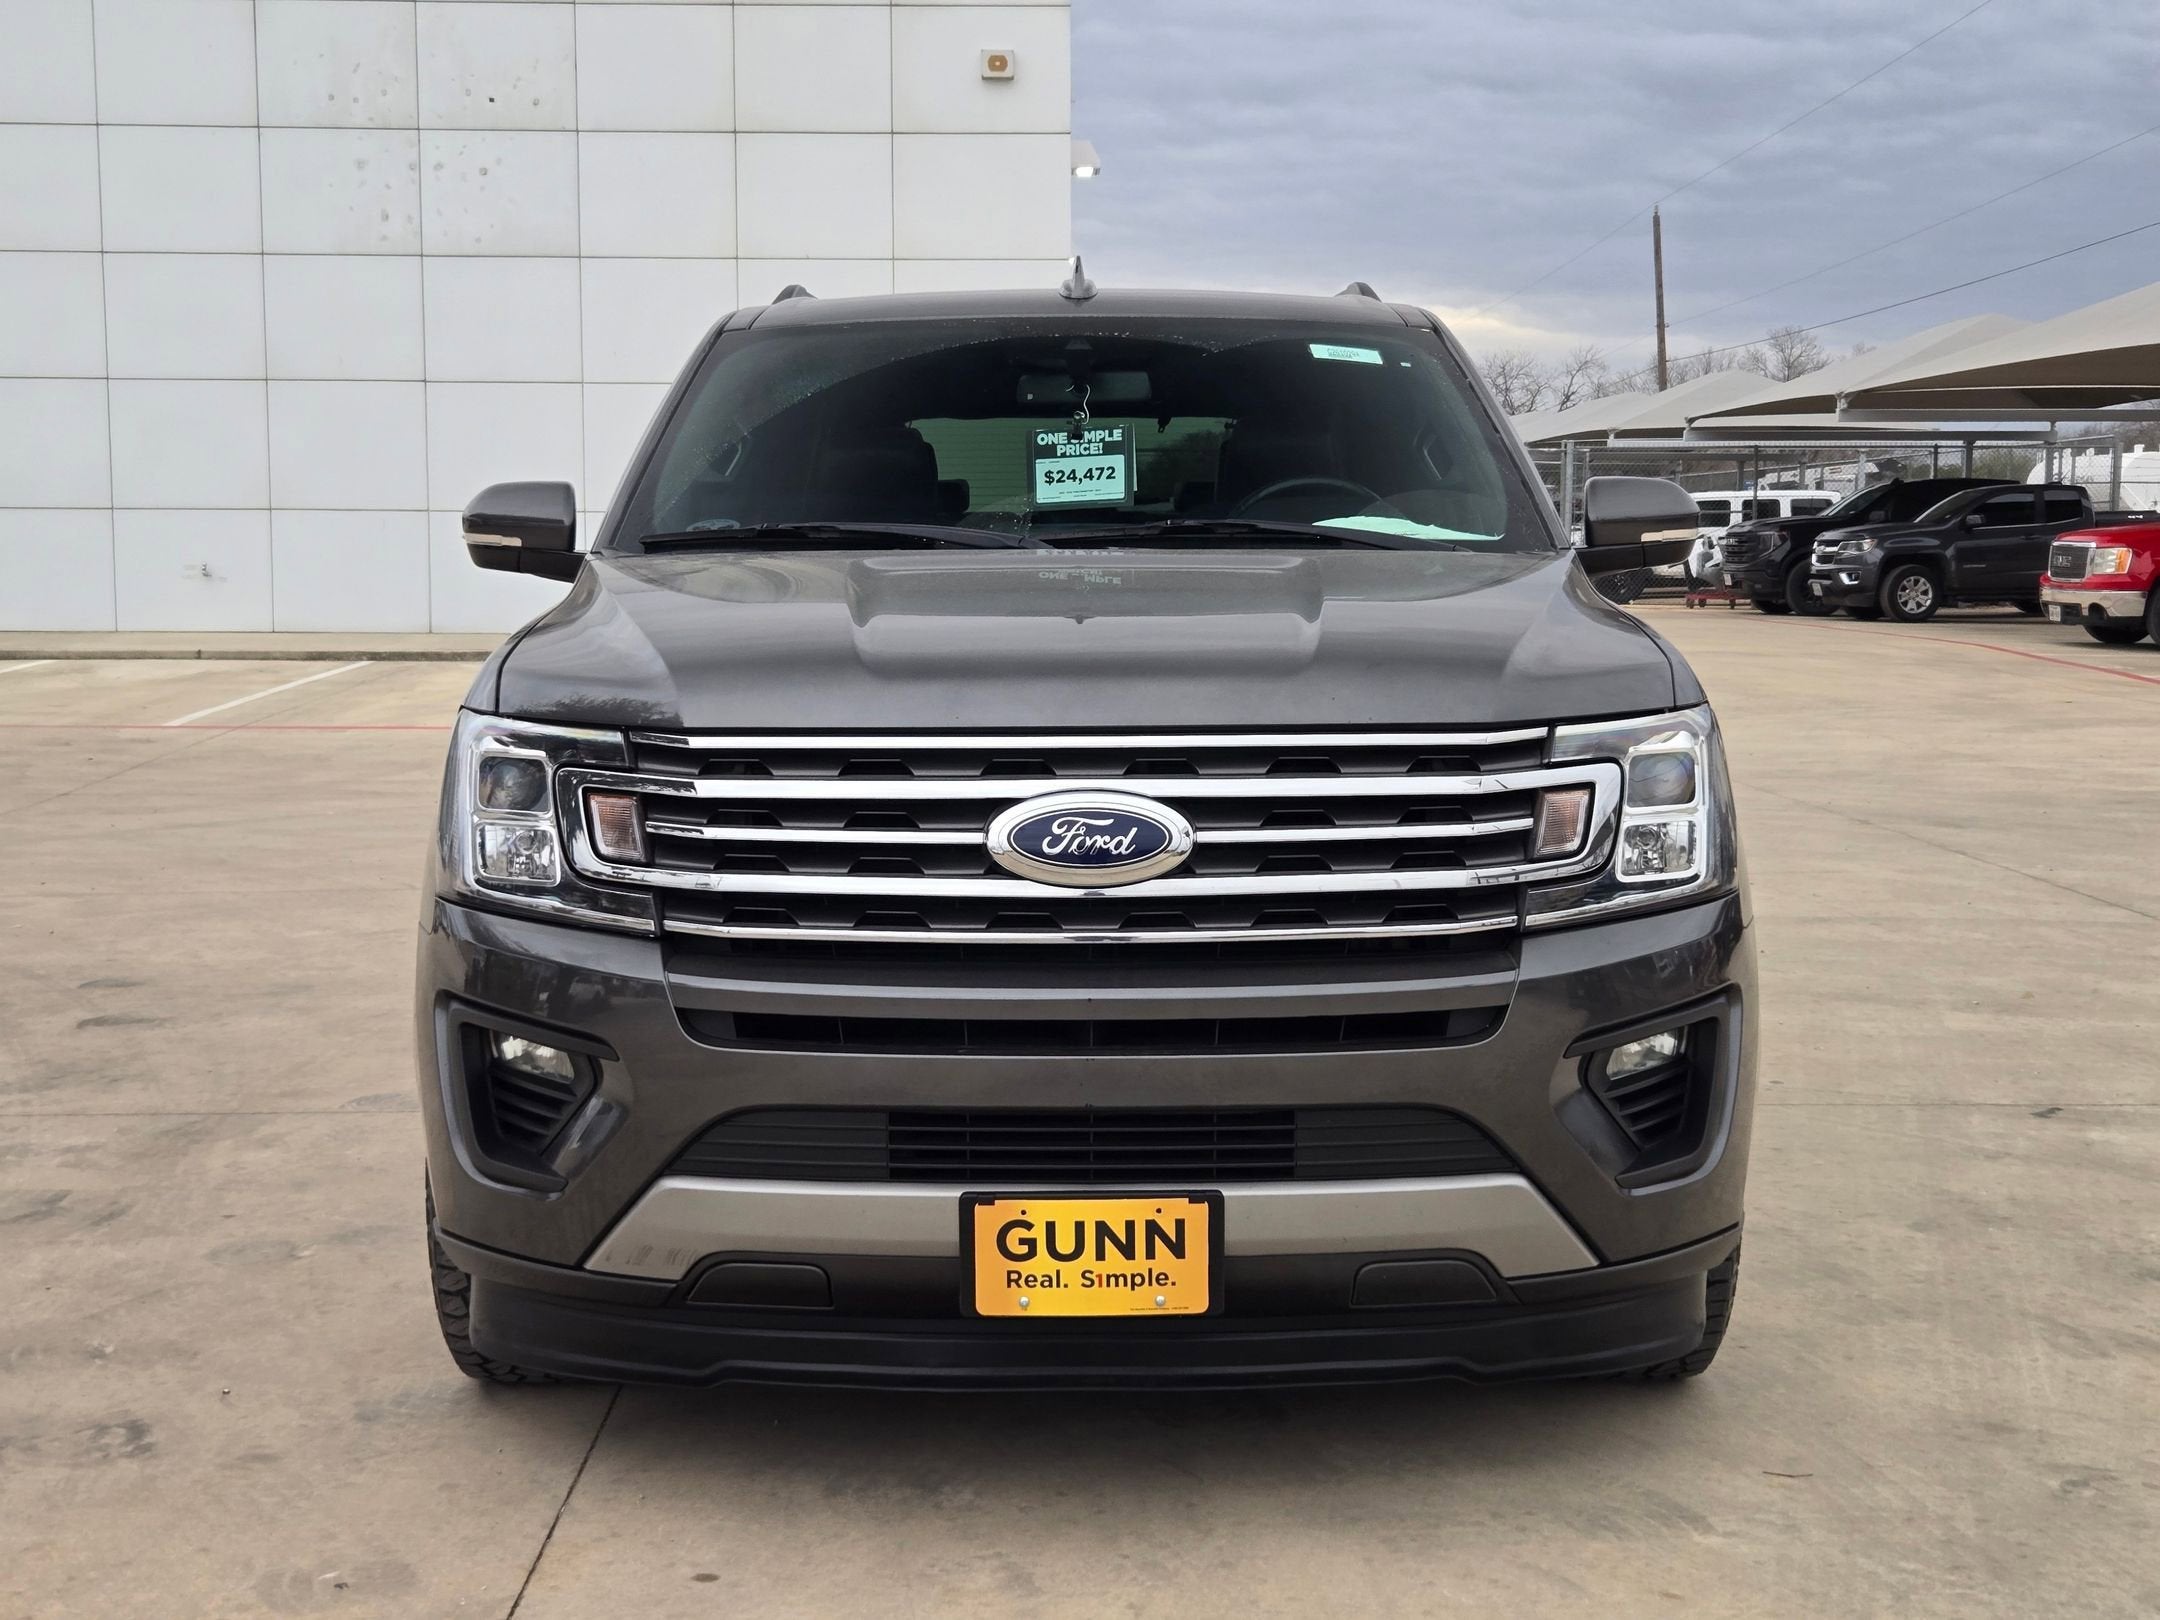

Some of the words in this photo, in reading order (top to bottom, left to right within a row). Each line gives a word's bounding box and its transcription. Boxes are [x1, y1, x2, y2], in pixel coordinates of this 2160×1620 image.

[1037, 432, 1068, 446] ONE
[1070, 429, 1122, 444] MPLE
[1056, 443, 1103, 457] PRICE!
[1044, 466, 1116, 486] $24,472
[1041, 816, 1138, 856] Ford
[996, 1218, 1187, 1263] GUNN
[1006, 1269, 1069, 1289] Real.
